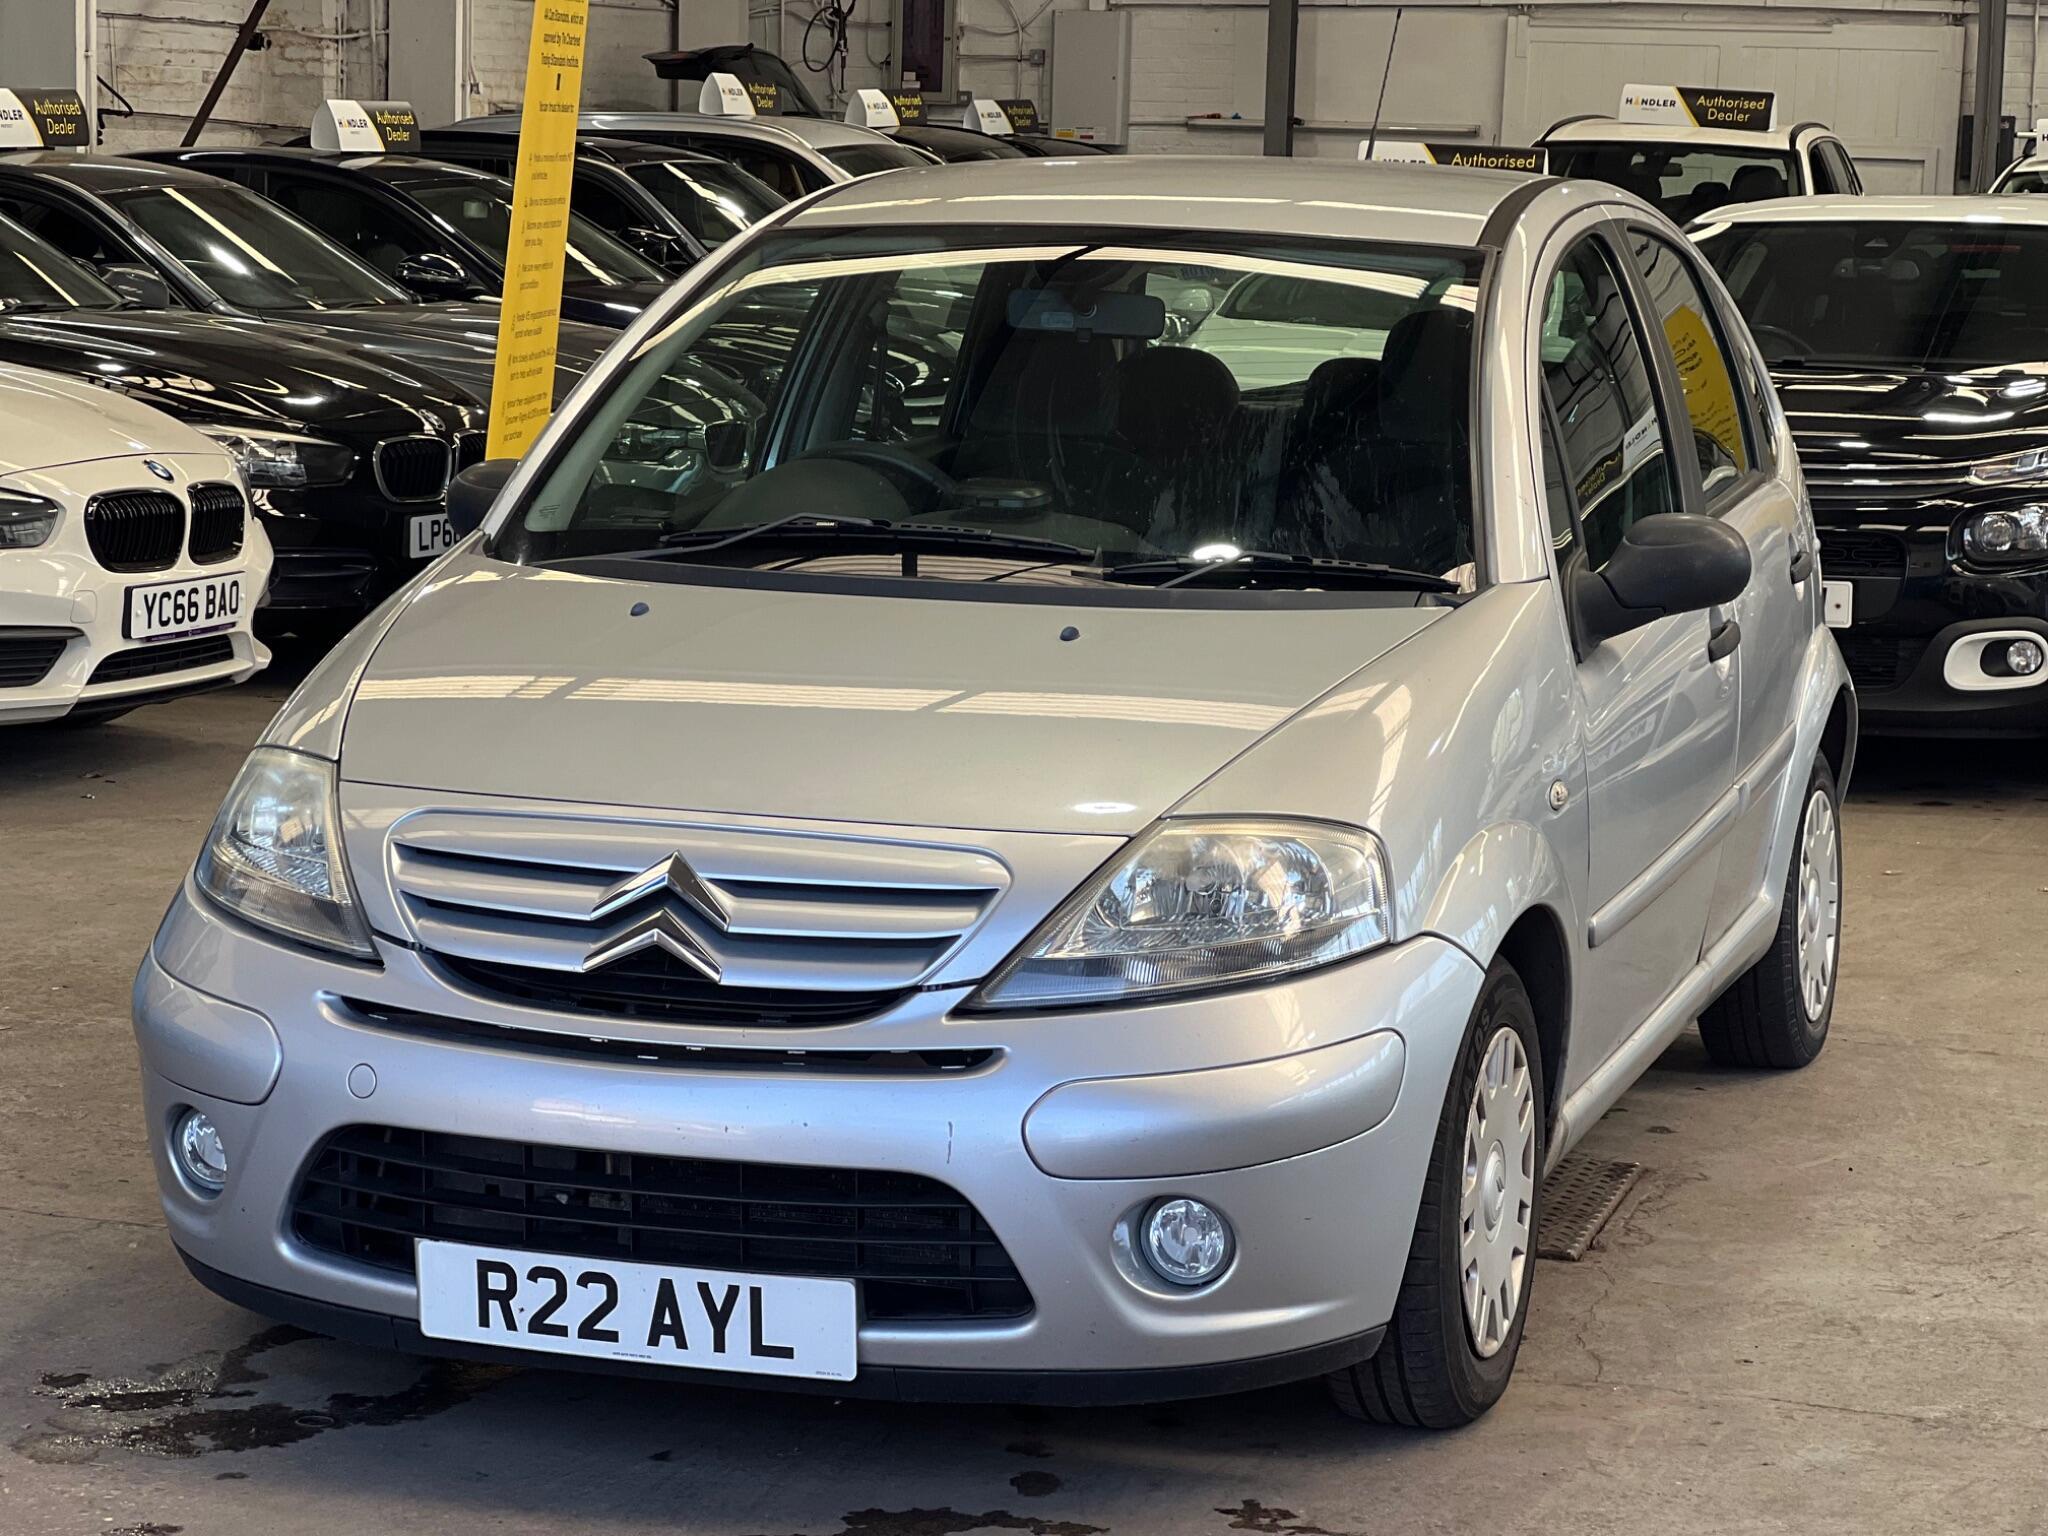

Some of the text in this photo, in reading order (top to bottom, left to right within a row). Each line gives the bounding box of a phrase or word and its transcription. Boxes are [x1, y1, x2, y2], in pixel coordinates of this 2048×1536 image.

[33, 98, 82, 115] Authorised
[1696, 94, 1766, 110] Authorised
[375, 109, 415, 125] Authorised
[1707, 107, 1750, 122] Dealer
[46, 117, 76, 134] Dealer
[386, 126, 410, 141] Dealer
[1451, 152, 1536, 169] Authorised
[144, 587, 199, 629] YC66
[476, 1258, 795, 1360] R22 AYL
